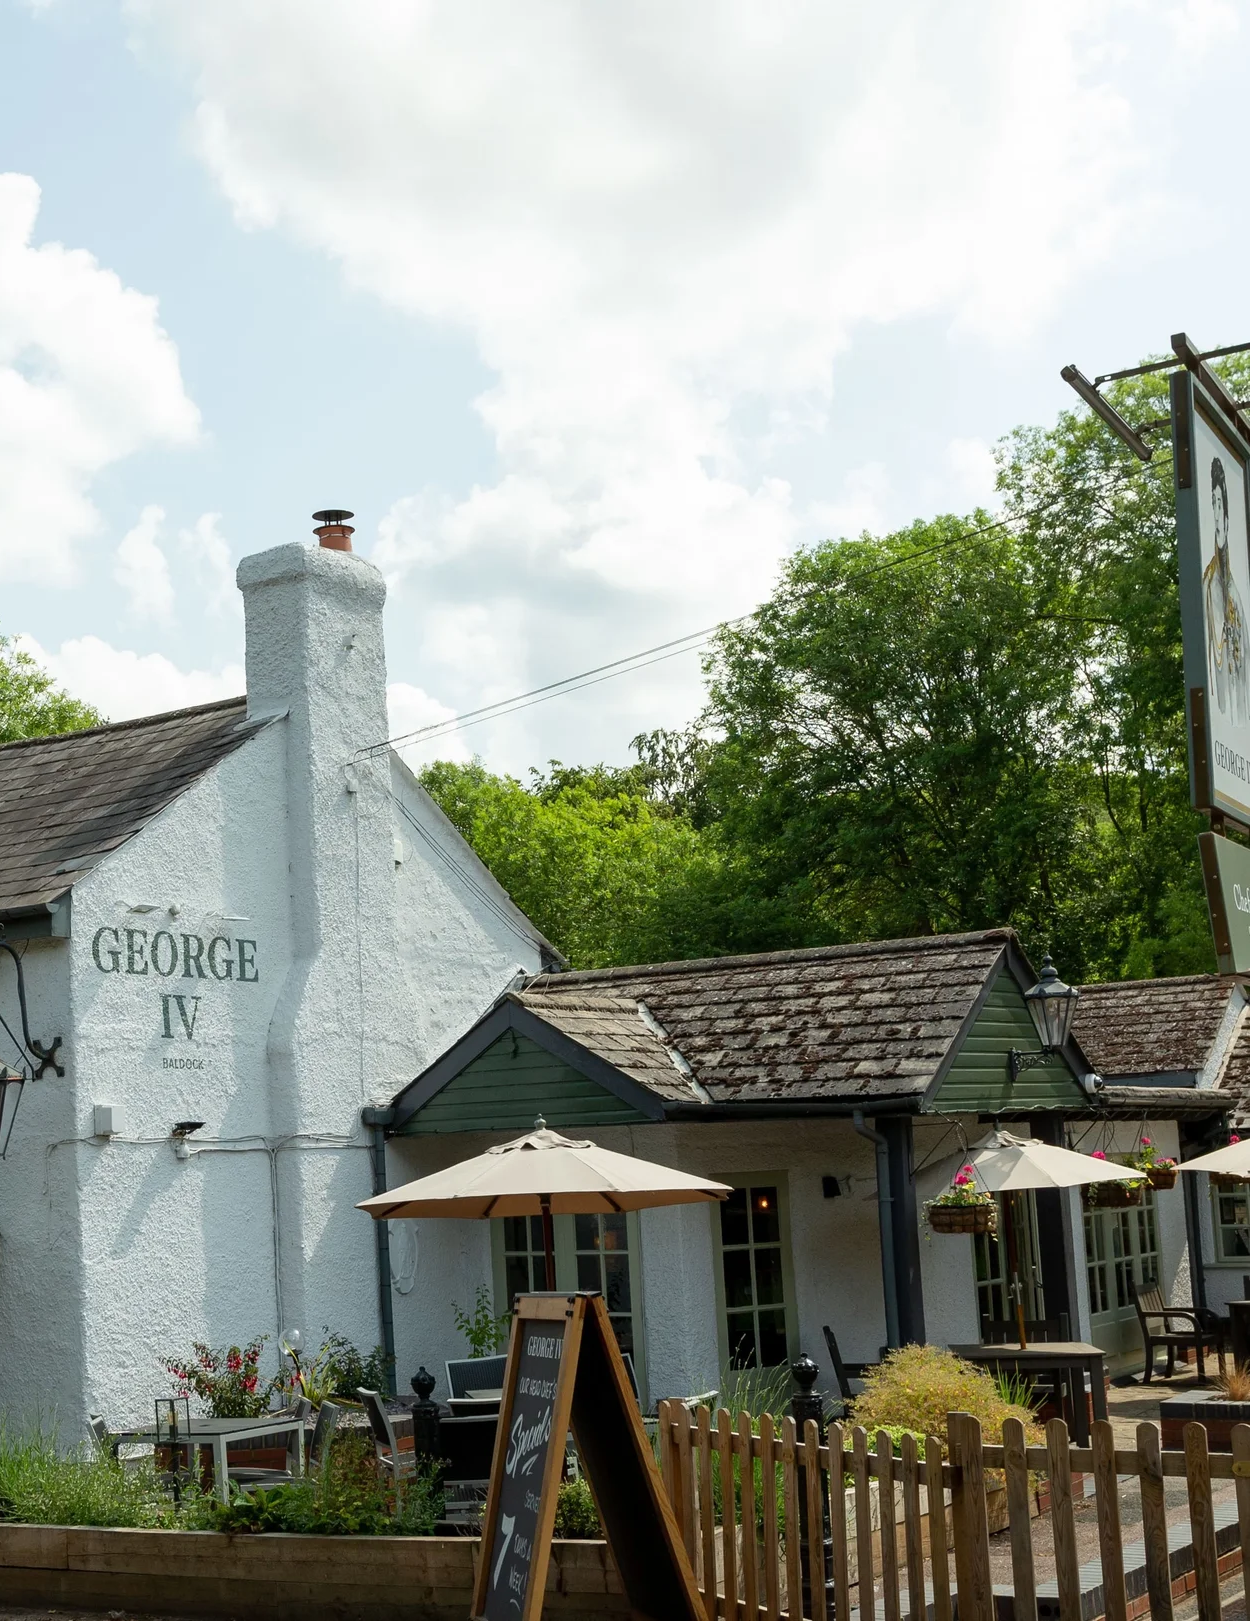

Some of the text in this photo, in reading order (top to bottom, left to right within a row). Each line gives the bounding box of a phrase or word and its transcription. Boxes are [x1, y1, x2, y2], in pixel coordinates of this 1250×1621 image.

[1215, 740, 1246, 781] GEORGE
[92, 926, 259, 982] GEORGE
[160, 992, 201, 1040] IV
[162, 1057, 204, 1070] BALDOCK
[528, 1336, 555, 1358] GEORGE
[506, 1405, 552, 1479] Specials
[493, 1513, 516, 1591] 7
